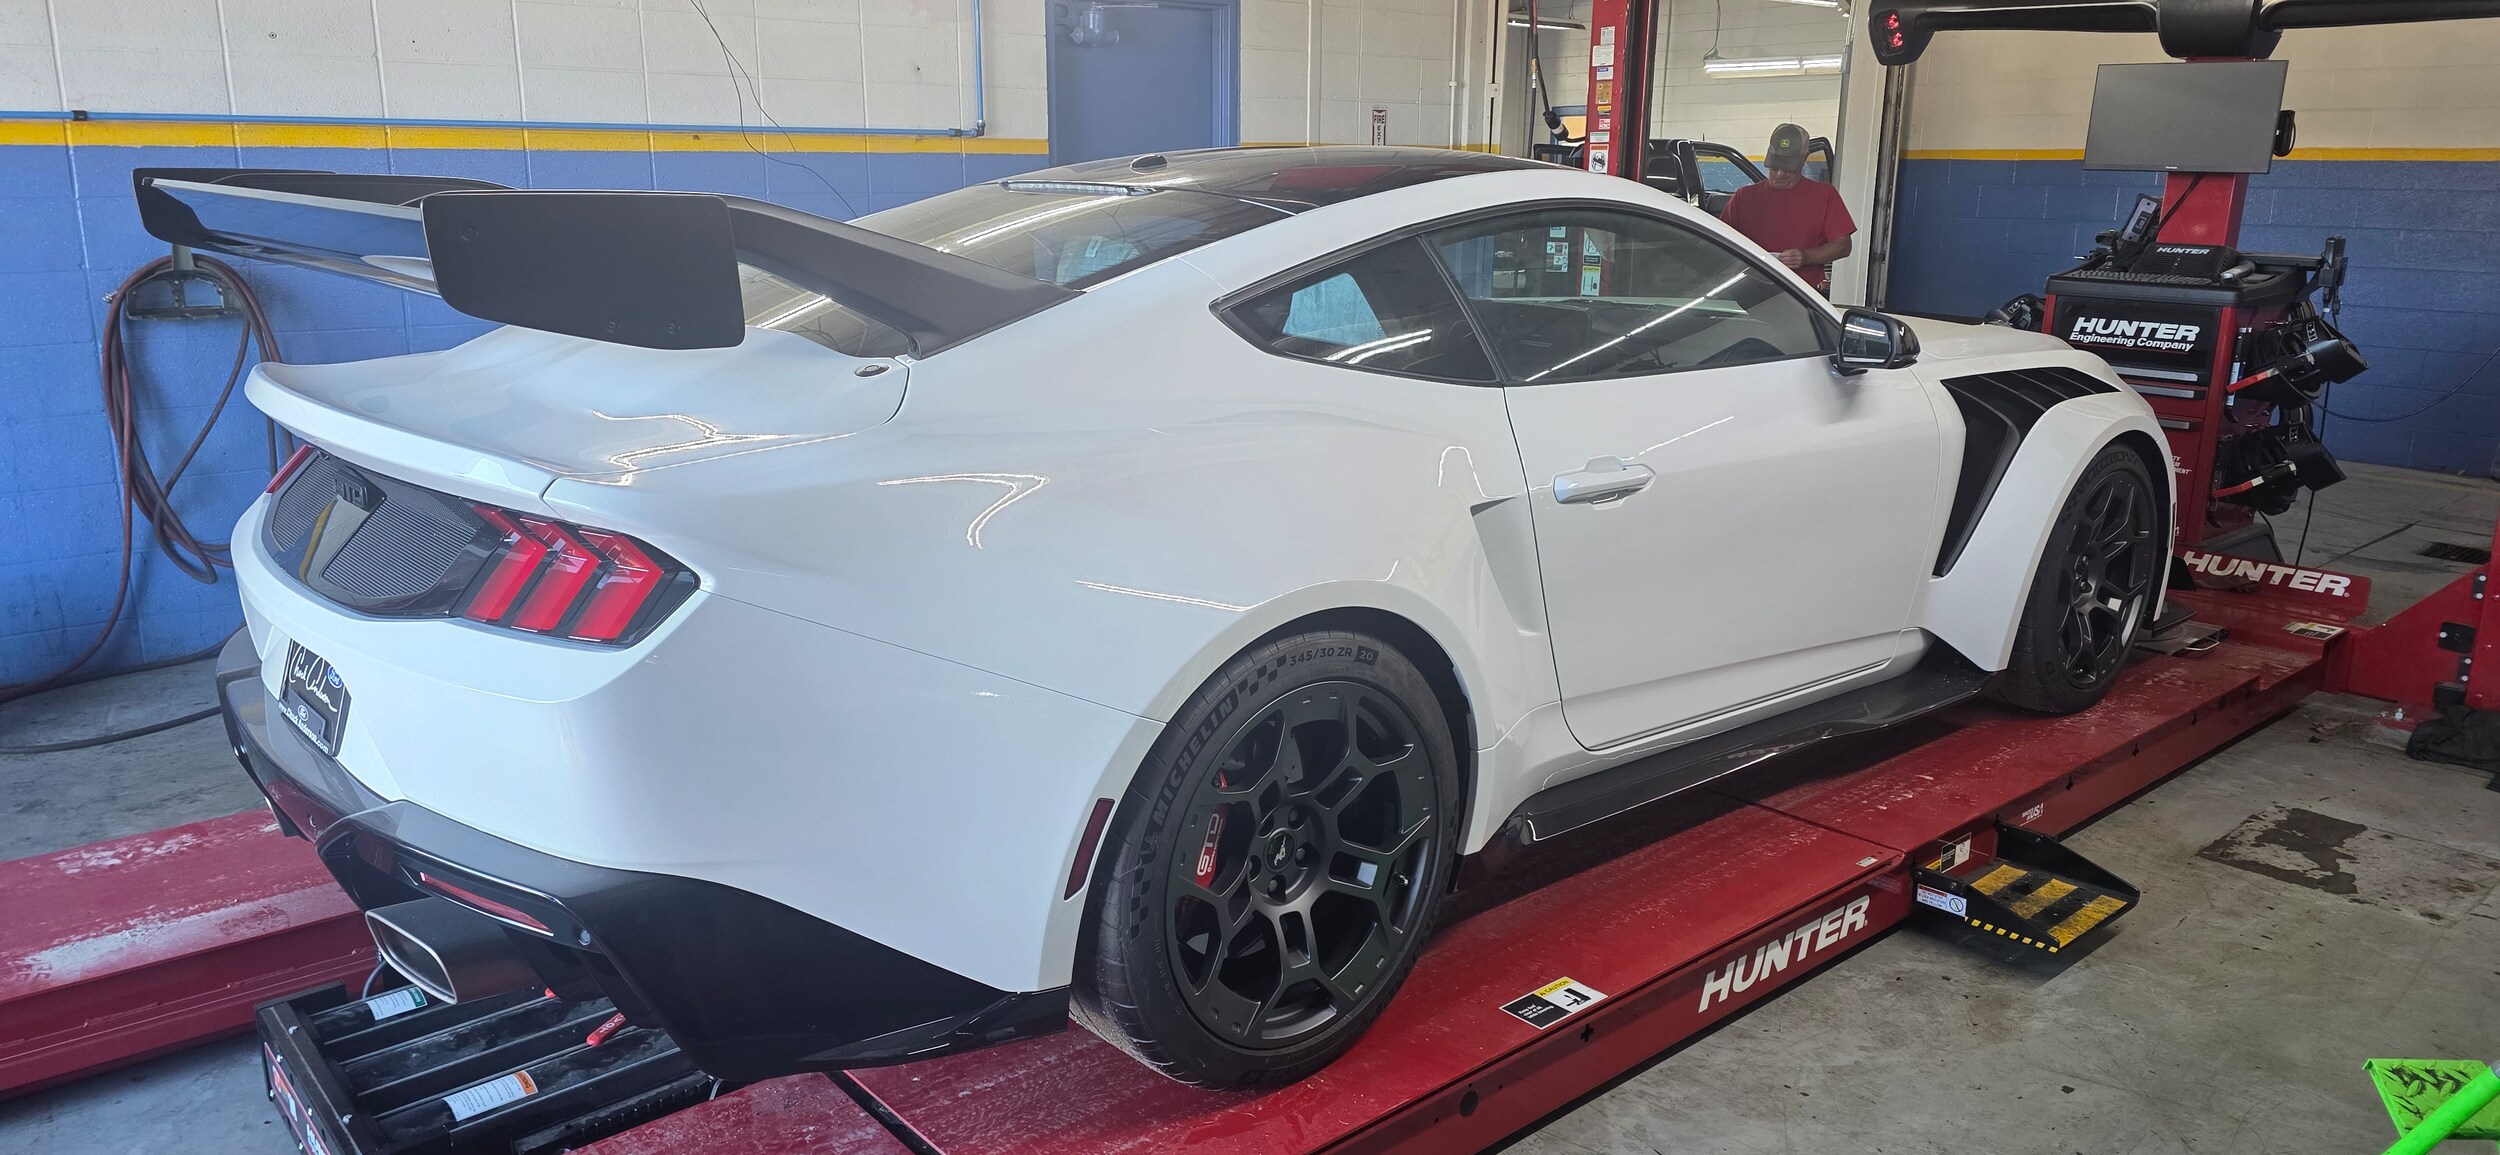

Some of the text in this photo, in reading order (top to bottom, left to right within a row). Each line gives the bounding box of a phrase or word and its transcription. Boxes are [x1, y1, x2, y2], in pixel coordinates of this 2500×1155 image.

[1374, 114, 1385, 124] FIRE
[2156, 247, 2211, 255] HUNTER
[2073, 316, 2200, 341] HUNTER
[2069, 331, 2194, 352] Engineering Company
[2183, 551, 2351, 597] HUNTER
[1290, 646, 1374, 667] 345/30 ZR 20
[1152, 693, 1235, 826] MICHELIN
[1197, 813, 1220, 876] GTD
[1698, 895, 1870, 1014] HUNTER
[1544, 980, 1570, 994] CAUTION
